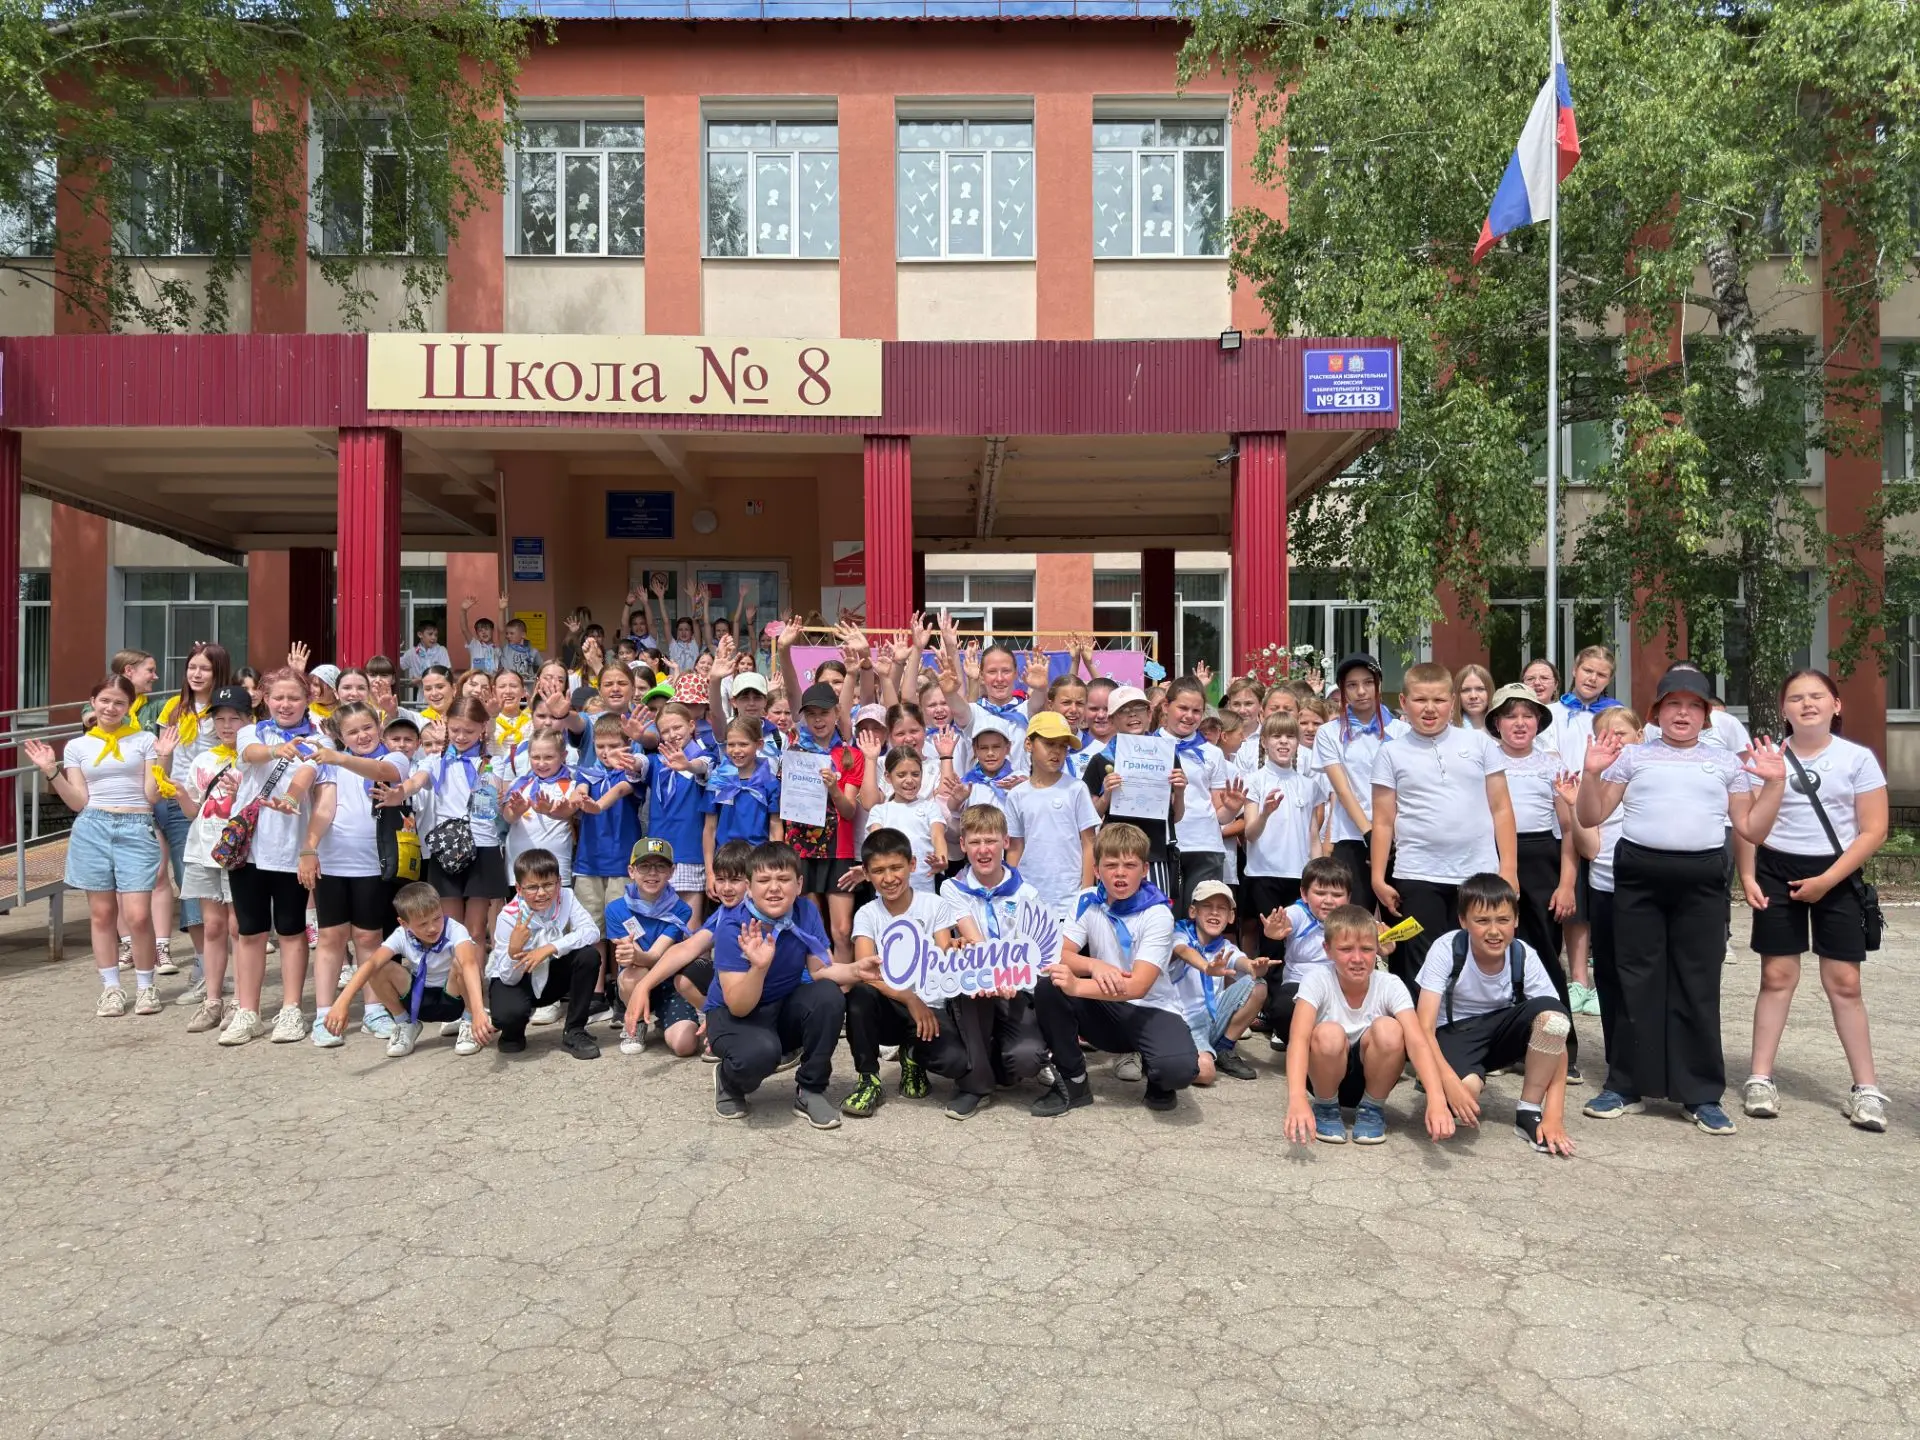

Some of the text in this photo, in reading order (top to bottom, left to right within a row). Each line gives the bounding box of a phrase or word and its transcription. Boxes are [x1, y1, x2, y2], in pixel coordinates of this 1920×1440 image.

[419, 343, 832, 406] Школа № 8
[1316, 394, 1376, 406] № 2113
[1123, 760, 1166, 772] Грамота
[788, 772, 822, 785] Грамота
[881, 919, 1030, 990] Орлята
[924, 964, 1031, 995] РОССИИ
